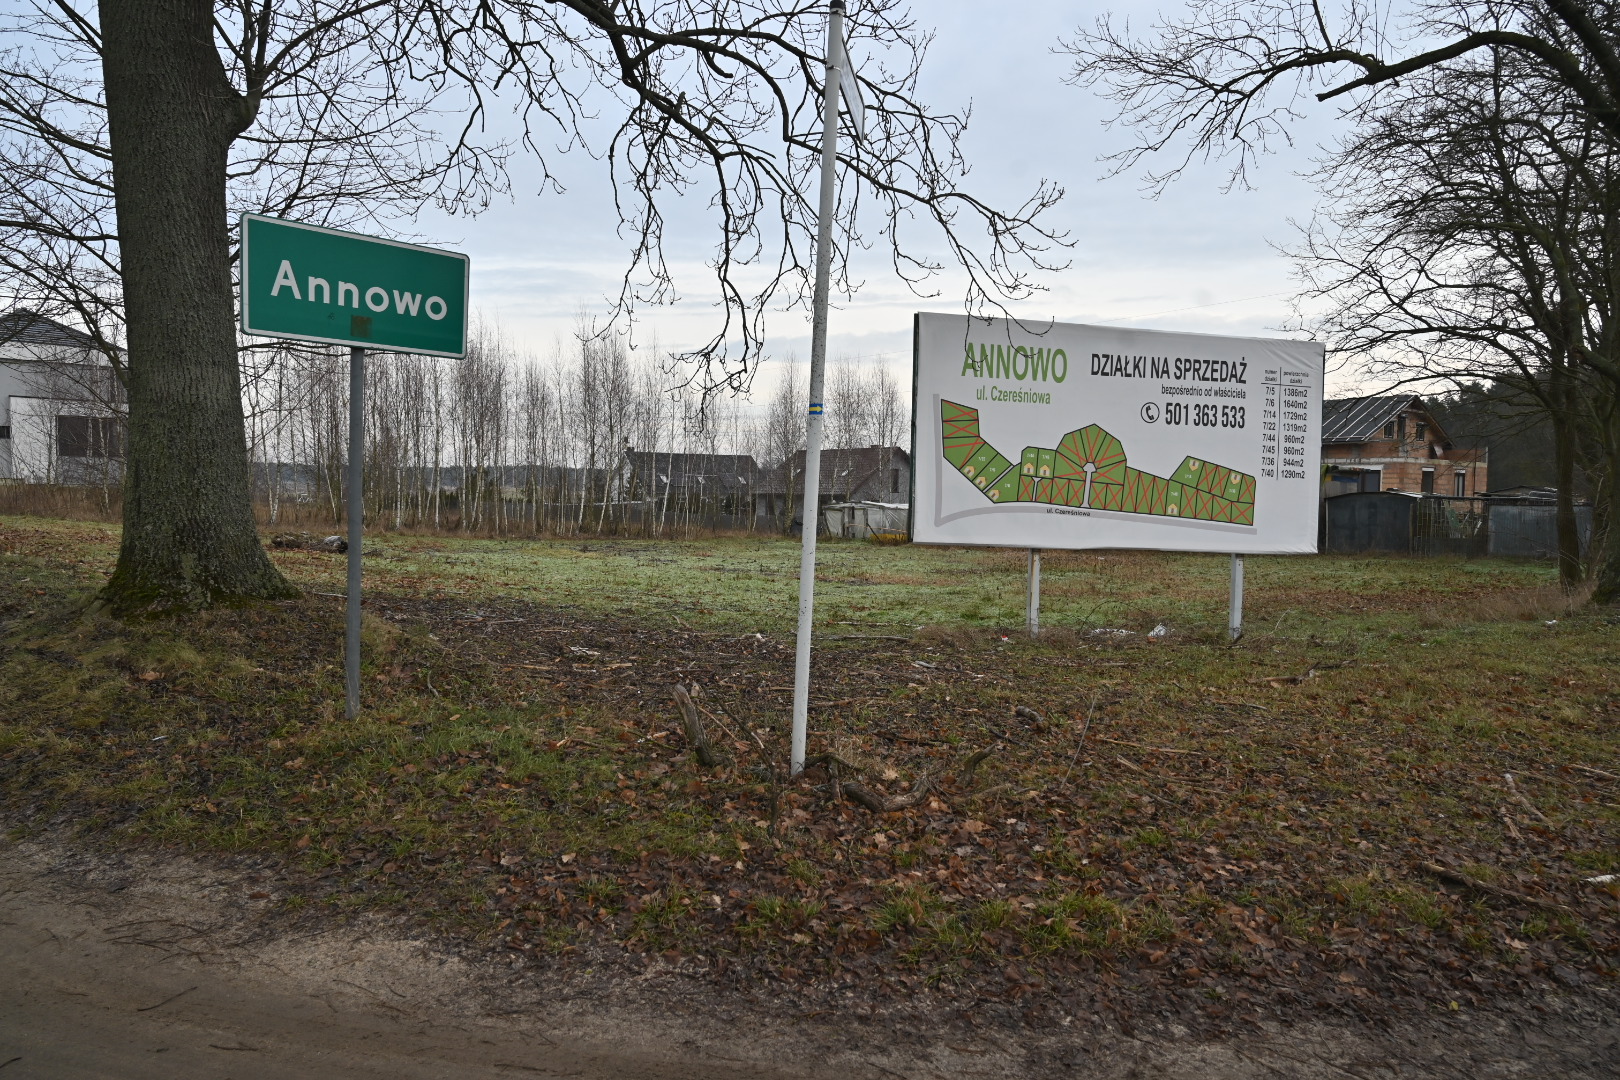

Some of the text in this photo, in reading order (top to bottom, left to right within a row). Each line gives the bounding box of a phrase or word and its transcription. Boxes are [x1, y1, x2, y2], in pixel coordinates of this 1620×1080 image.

[270, 259, 448, 321] Annowo
[961, 342, 1068, 384] ANNOWO
[1091, 353, 1248, 385] DZIAŁKI NA SPRZEDAŻ
[976, 385, 1051, 405] ul. Czereśniowa
[1161, 384, 1247, 399] bezpośrednio od właściciela
[1265, 386, 1308, 398] 7/5 1386m2
[1265, 398, 1308, 410] 7/6 1640m2
[1165, 402, 1246, 429] 501 363 533
[1263, 409, 1307, 421] 7/14 1729m2
[1262, 421, 1307, 433] 7/22 1319m2
[1262, 433, 1276, 443] 7/44
[1262, 445, 1305, 456] 7/45 960m2
[1261, 456, 1304, 468] 7/36 944m2
[1261, 468, 1306, 479] 7/40 1290m2
[1054, 508, 1091, 517] Czereśniowa
